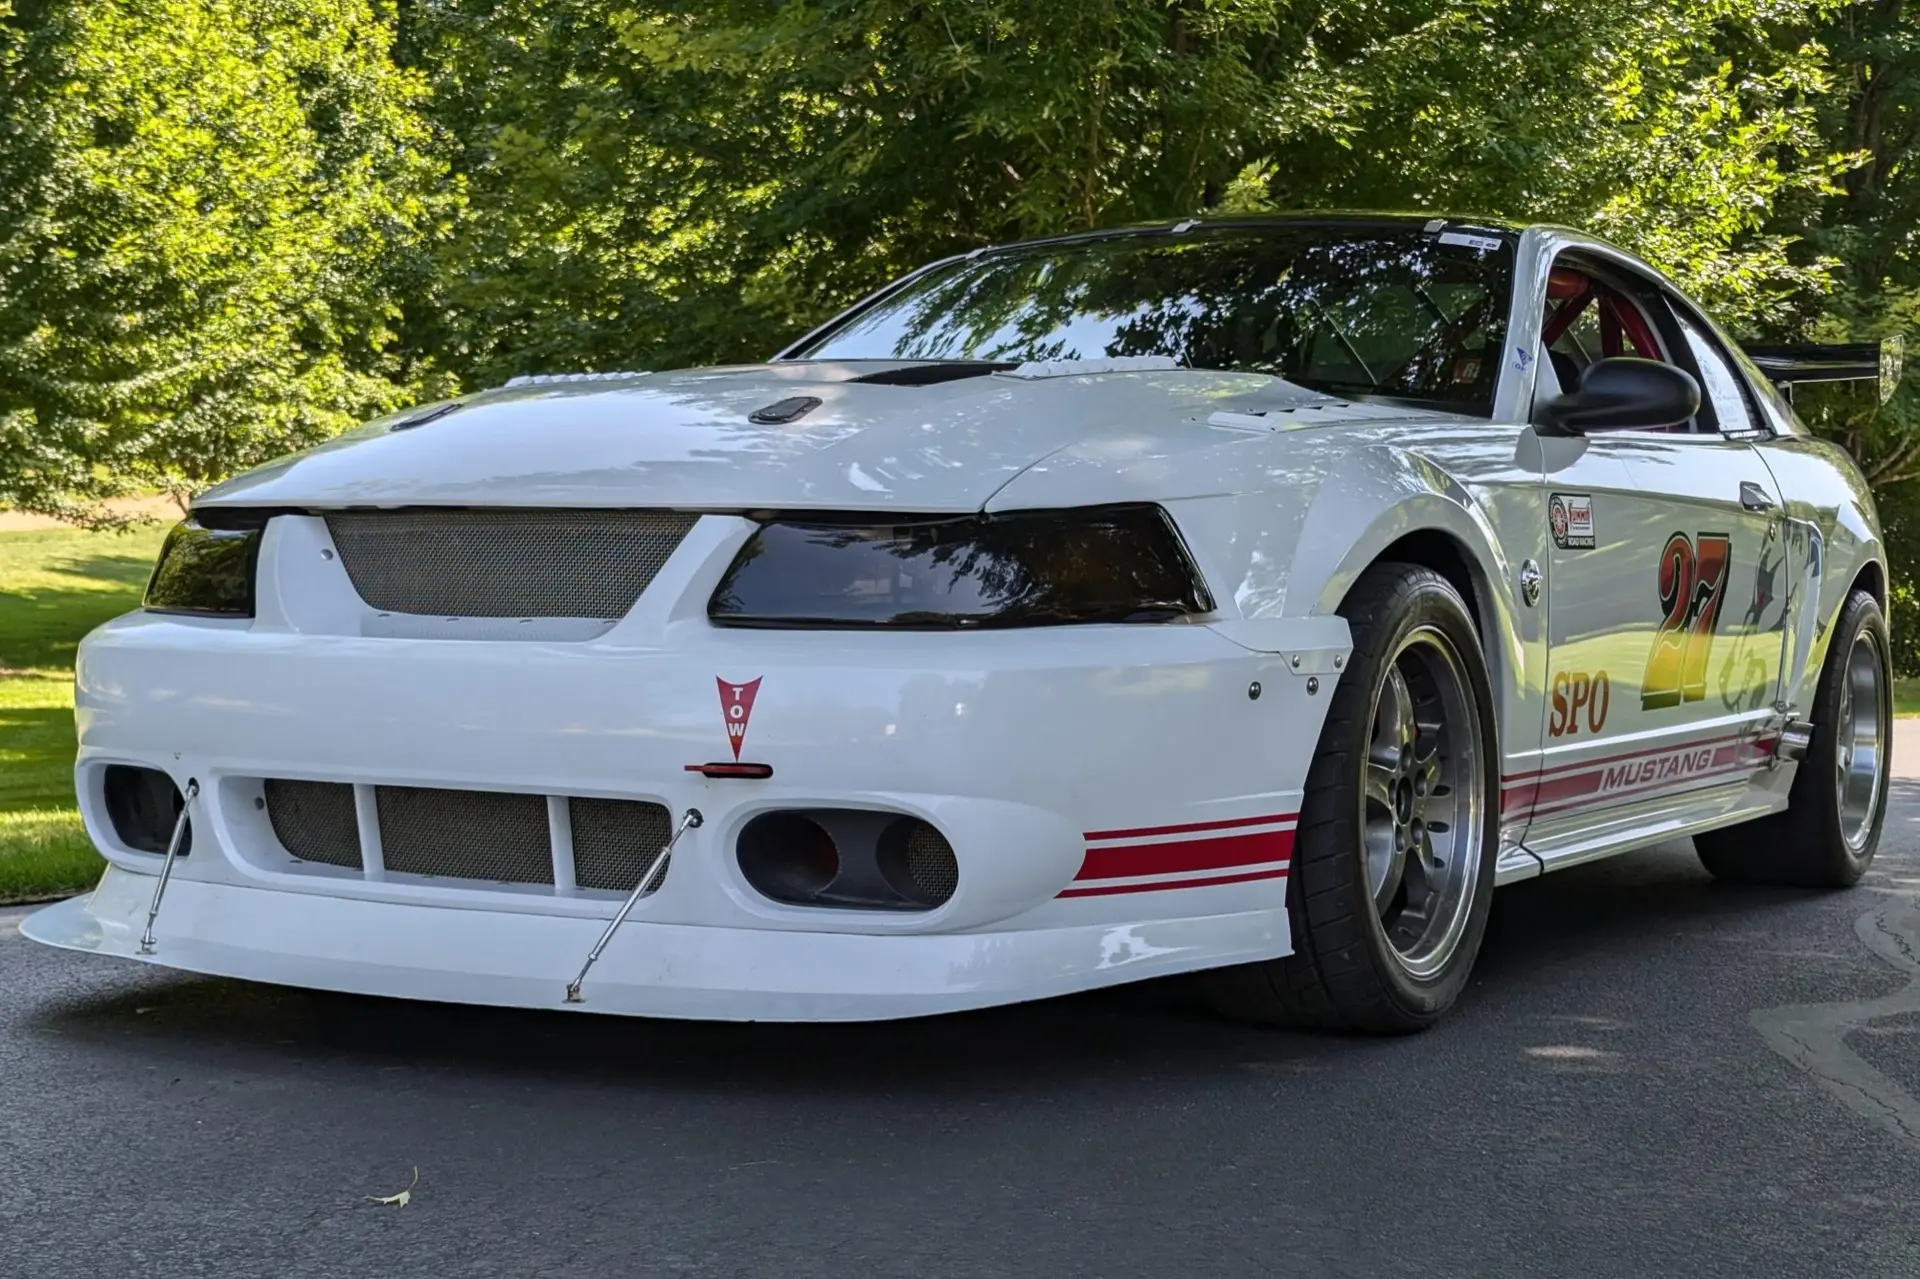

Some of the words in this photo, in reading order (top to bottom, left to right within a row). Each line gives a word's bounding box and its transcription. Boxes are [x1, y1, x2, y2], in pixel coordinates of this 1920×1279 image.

[1641, 531, 1732, 711] 27
[728, 687, 745, 737] TOW
[1549, 670, 1610, 737] SPO
[1603, 749, 1711, 790] MUSTANG
